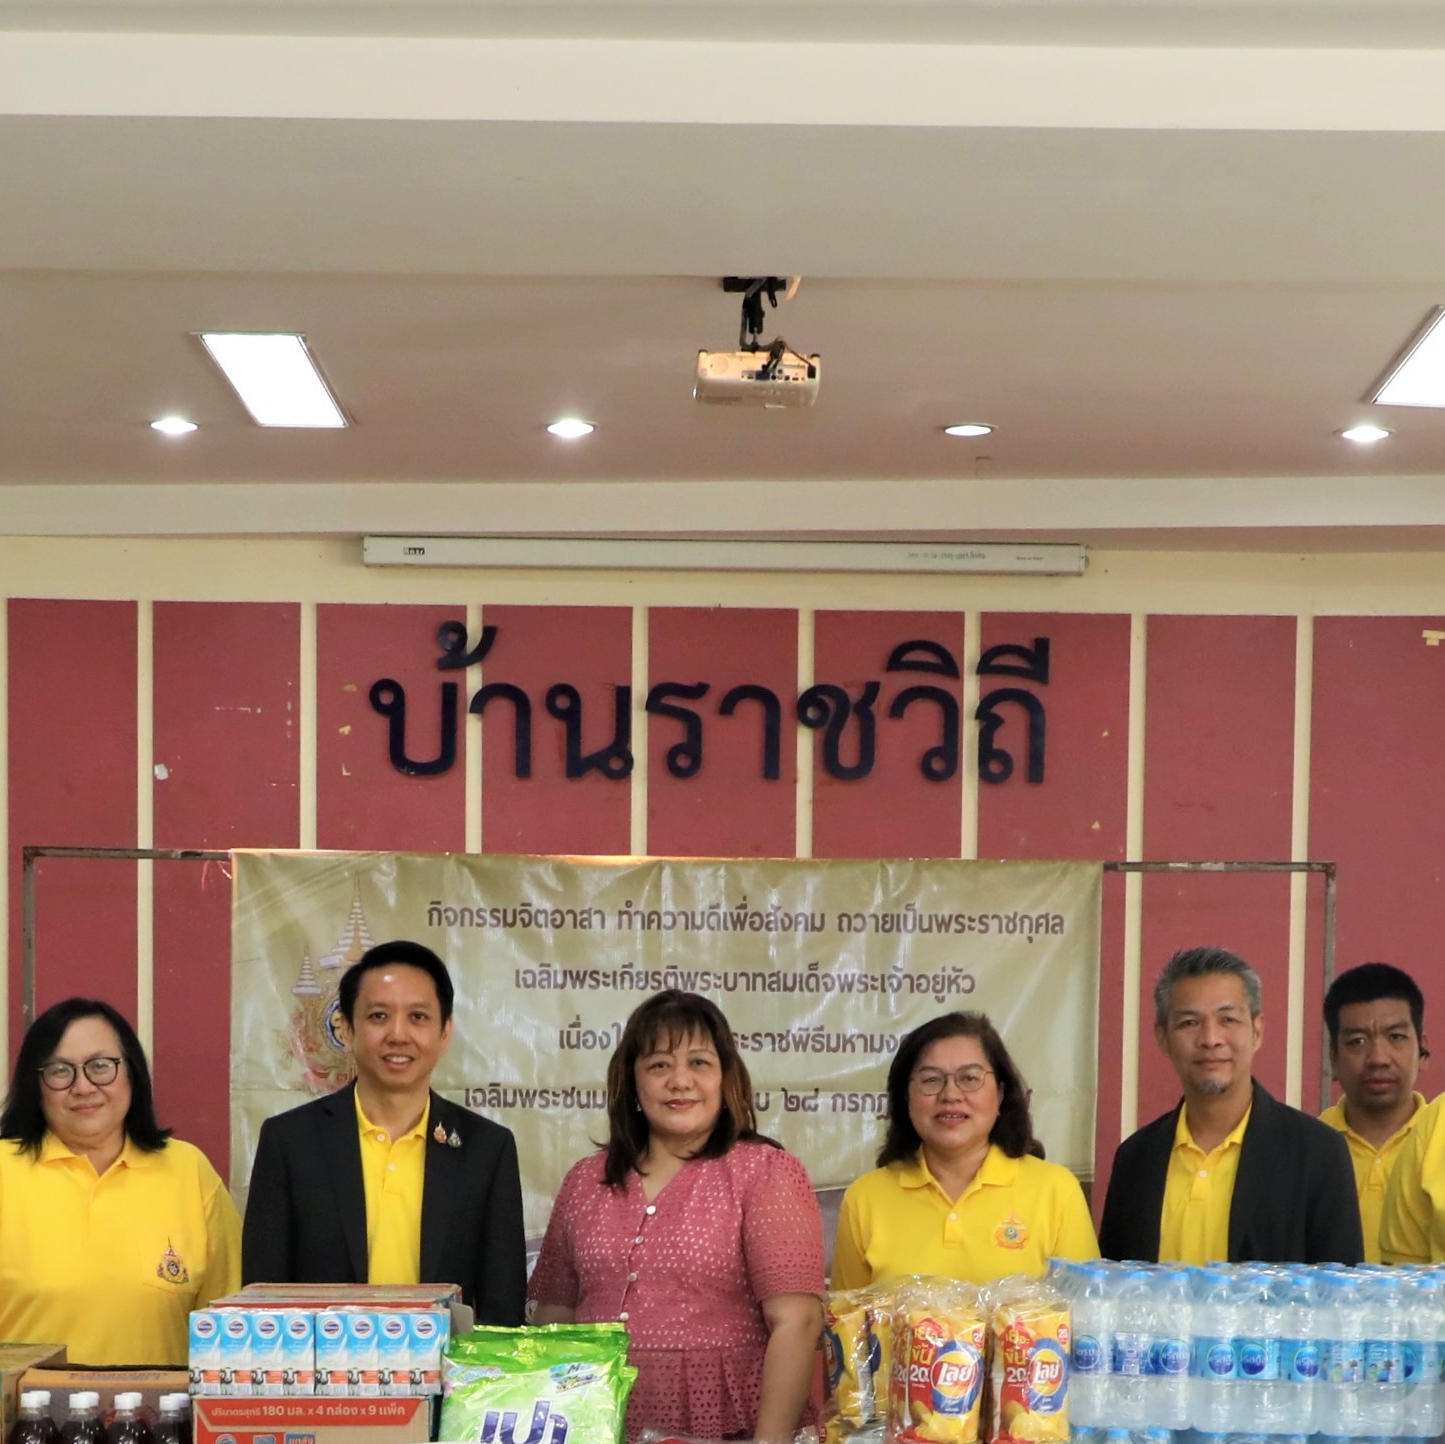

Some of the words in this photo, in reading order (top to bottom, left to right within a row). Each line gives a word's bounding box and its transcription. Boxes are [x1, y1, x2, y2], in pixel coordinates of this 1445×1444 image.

[369, 620, 1050, 784] บ้านราชวิถี
[427, 900, 606, 930] กิจกรรมจิตอาสา
[618, 896, 825, 935] ทำความดีเพื่อสังคม
[838, 902, 1064, 944] ถวายเป็นพระราชกุศล
[515, 961, 976, 1003] เฉลิมพระเกียรติพระบาทสมเด็จพระเจ้าอยู่หัว
[783, 1087, 819, 1113] ๒๘
[262, 1405, 285, 1416] 180
[315, 1405, 324, 1415] 4
[326, 1404, 359, 1416] กล่อง
[368, 1405, 376, 1415] 9
[379, 1402, 405, 1416] แพ็ค
